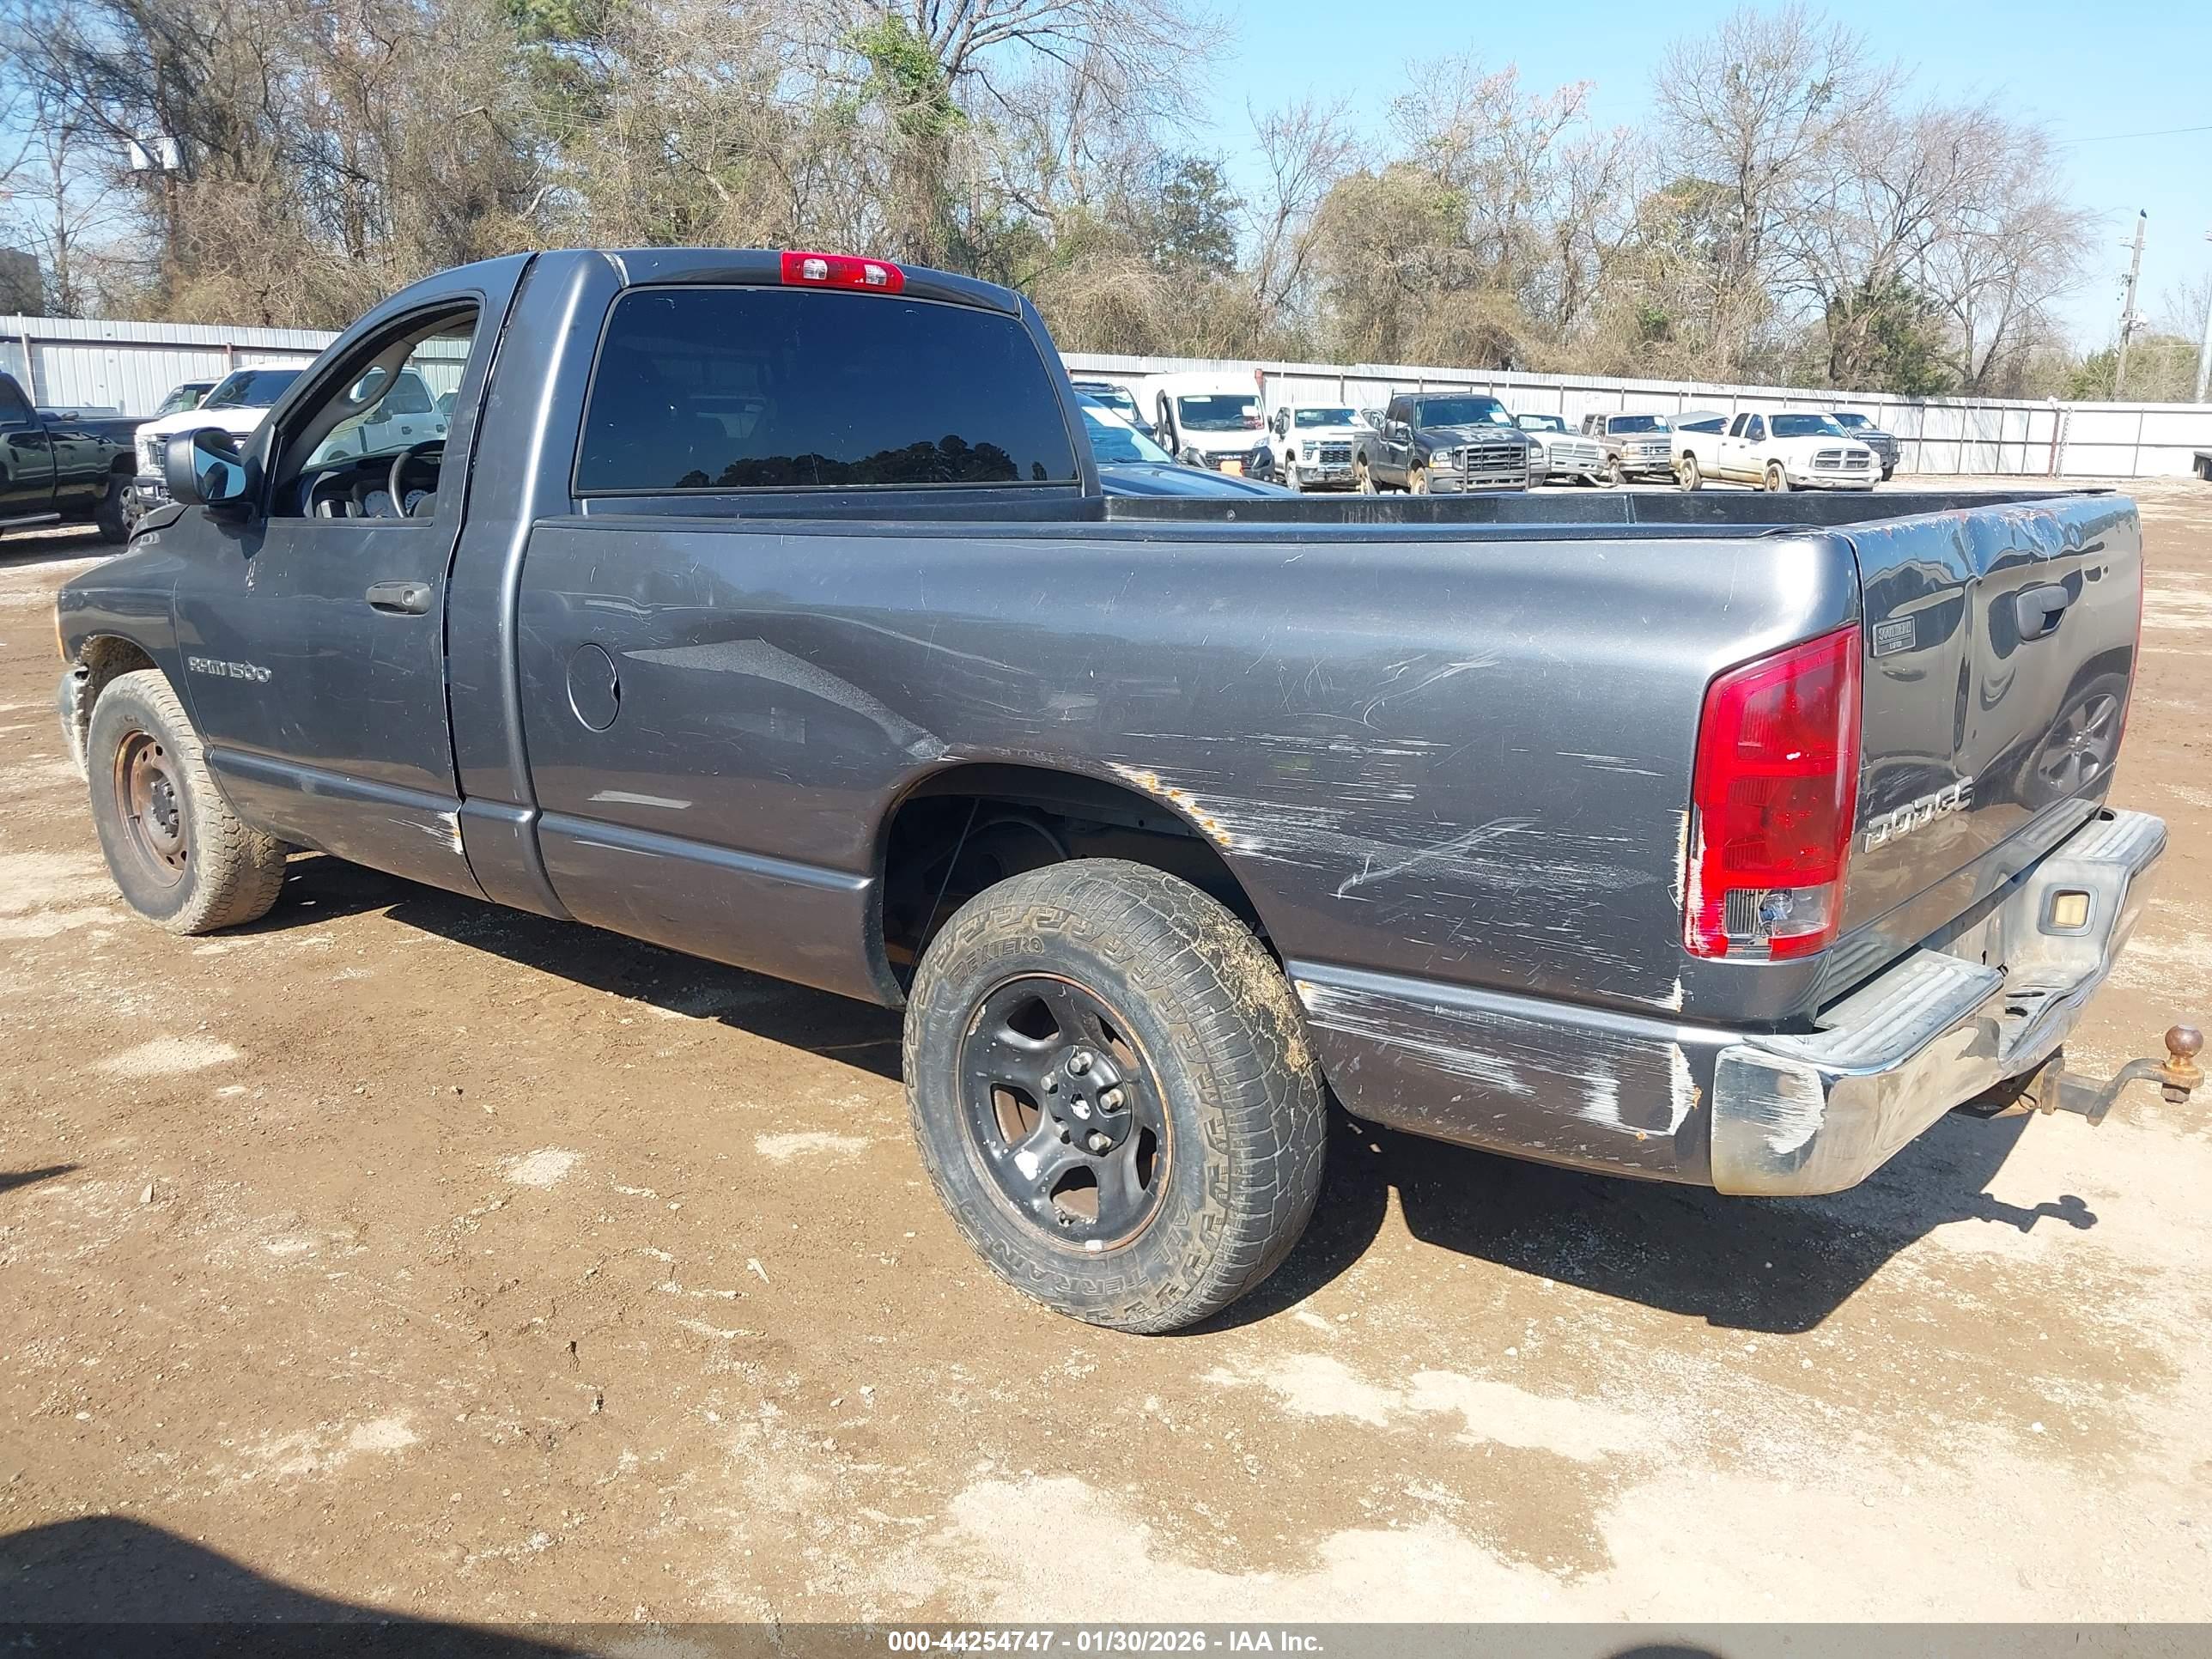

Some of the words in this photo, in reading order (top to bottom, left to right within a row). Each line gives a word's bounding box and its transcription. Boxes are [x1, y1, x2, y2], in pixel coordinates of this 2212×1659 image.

[188, 656, 227, 677] RAM
[227, 660, 272, 684] 1500
[1861, 775, 1975, 854] DODGE
[947, 935, 1045, 987] DEXTERO
[1152, 1195, 1190, 1264] ALL
[992, 1237, 1149, 1297] TERRAIN
